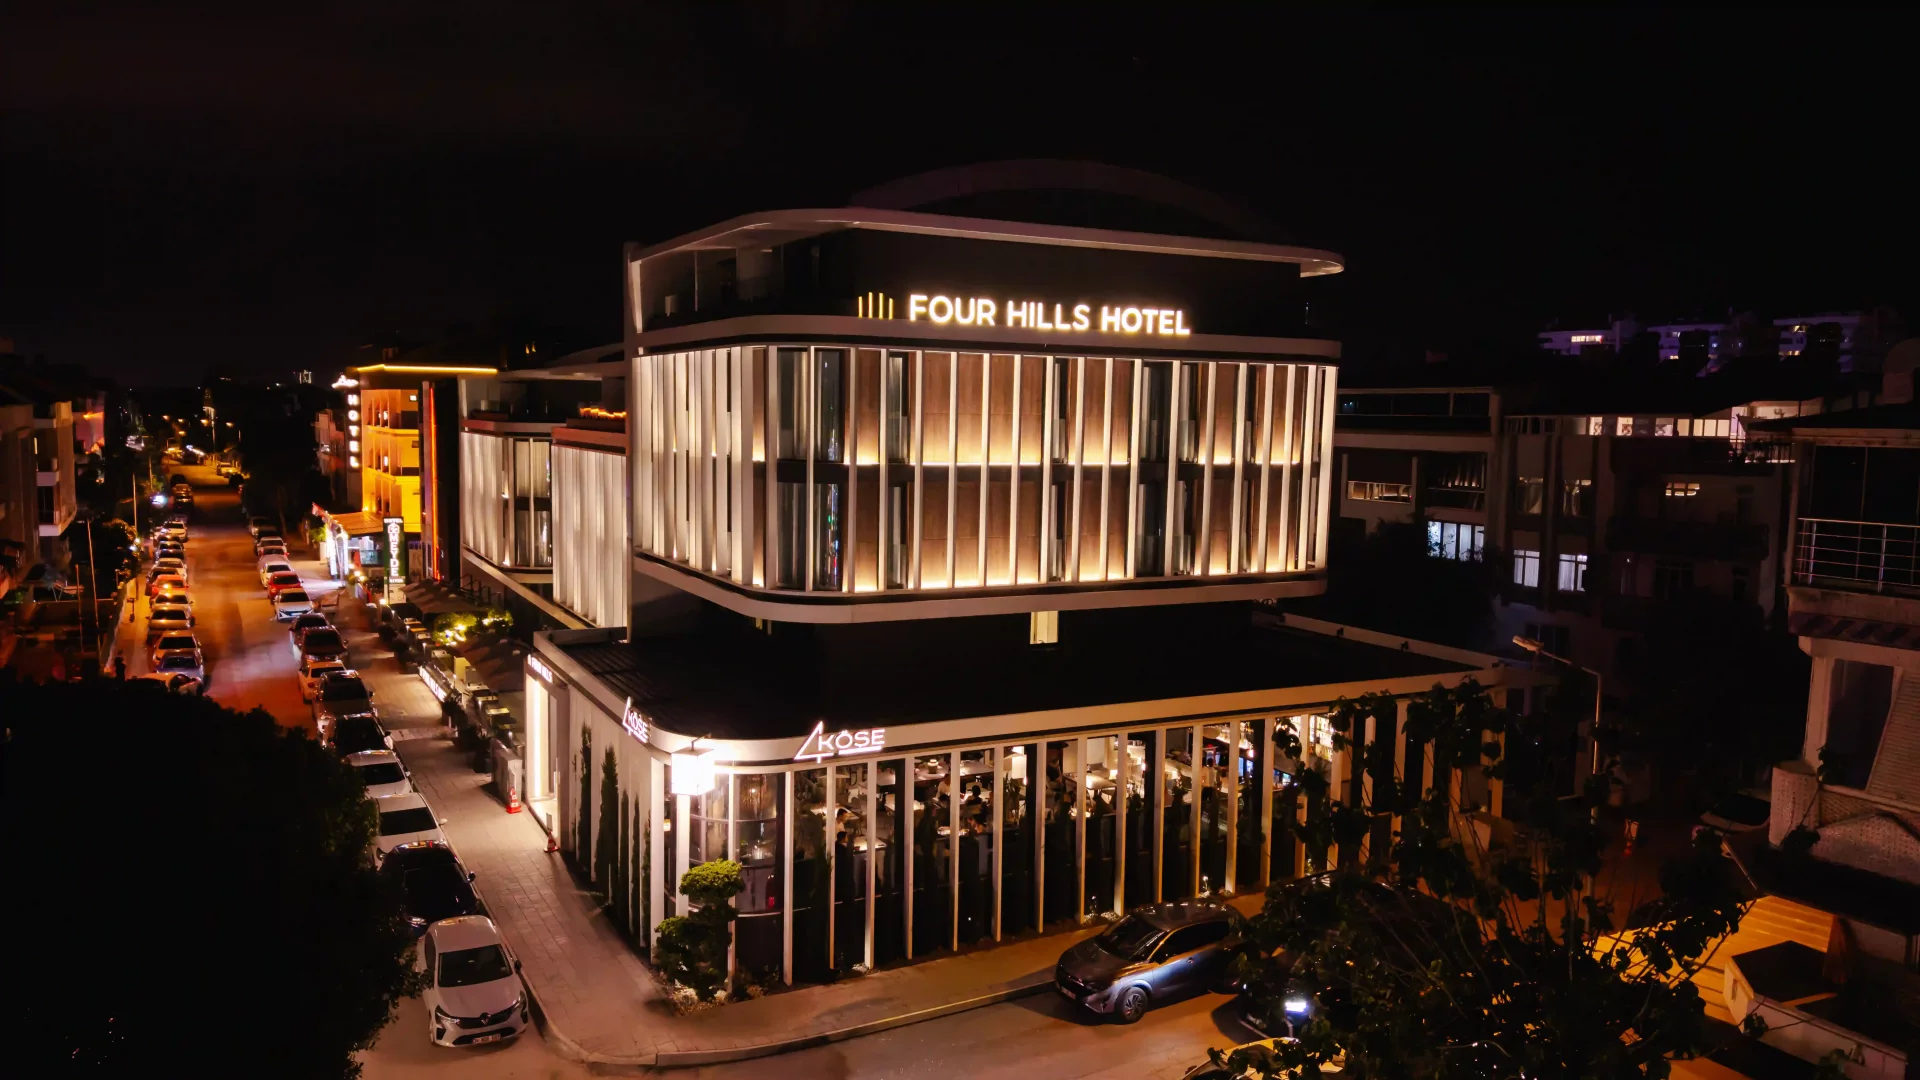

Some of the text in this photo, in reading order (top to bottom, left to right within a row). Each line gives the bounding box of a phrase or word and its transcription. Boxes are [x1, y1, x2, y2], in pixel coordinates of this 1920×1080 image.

[909, 294, 1191, 335] FOUR HILLS HOTEL
[347, 394, 360, 468] HOTEL
[389, 533, 400, 577] MEYDE
